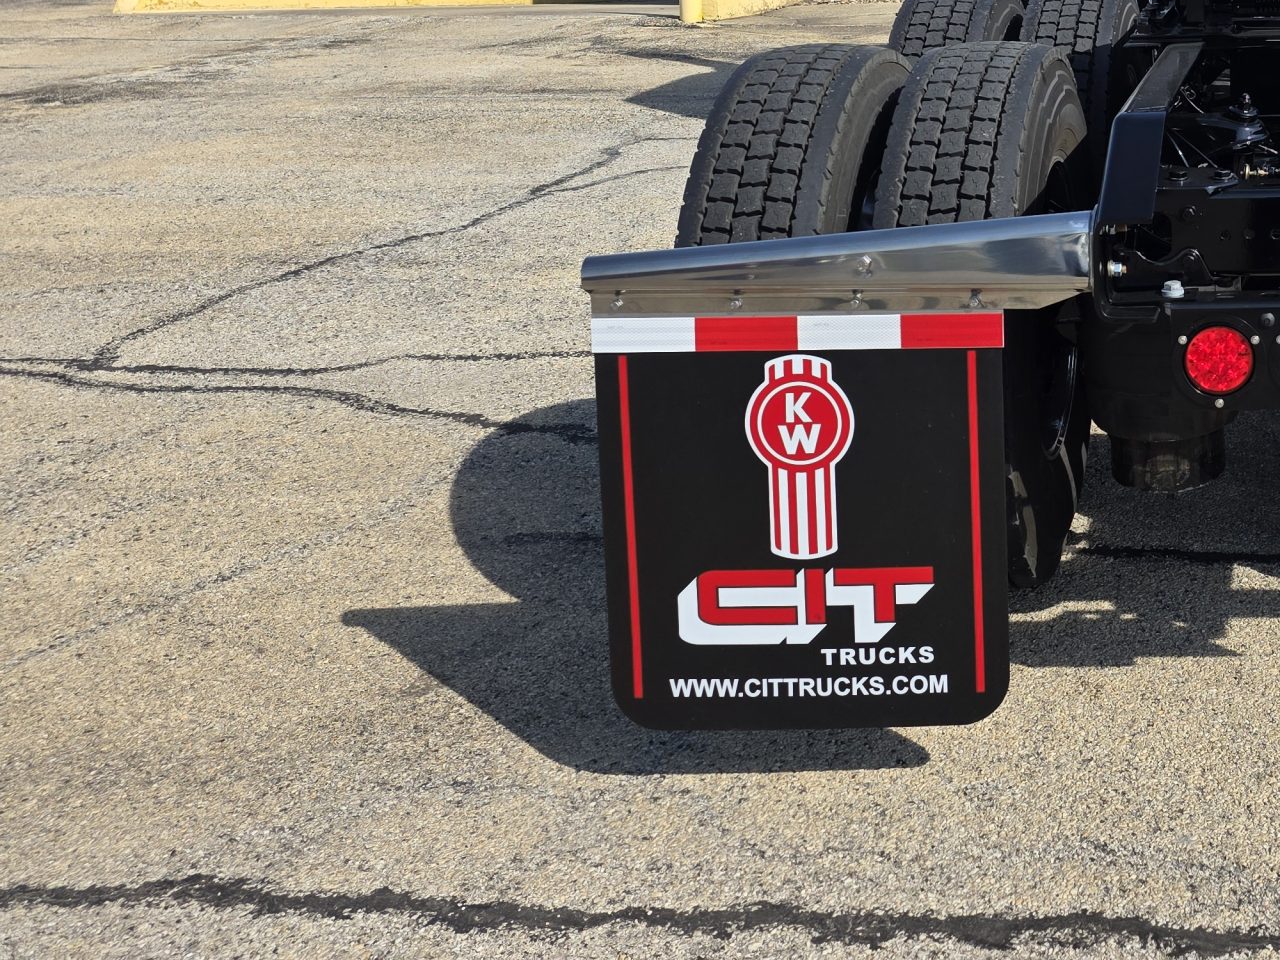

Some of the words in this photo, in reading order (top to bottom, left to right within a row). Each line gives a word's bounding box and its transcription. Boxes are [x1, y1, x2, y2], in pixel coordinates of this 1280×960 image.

[677, 565, 936, 646] CIT
[820, 646, 935, 666] TRUCKS
[669, 674, 949, 699] WWW.CITTRUCKS.COM
